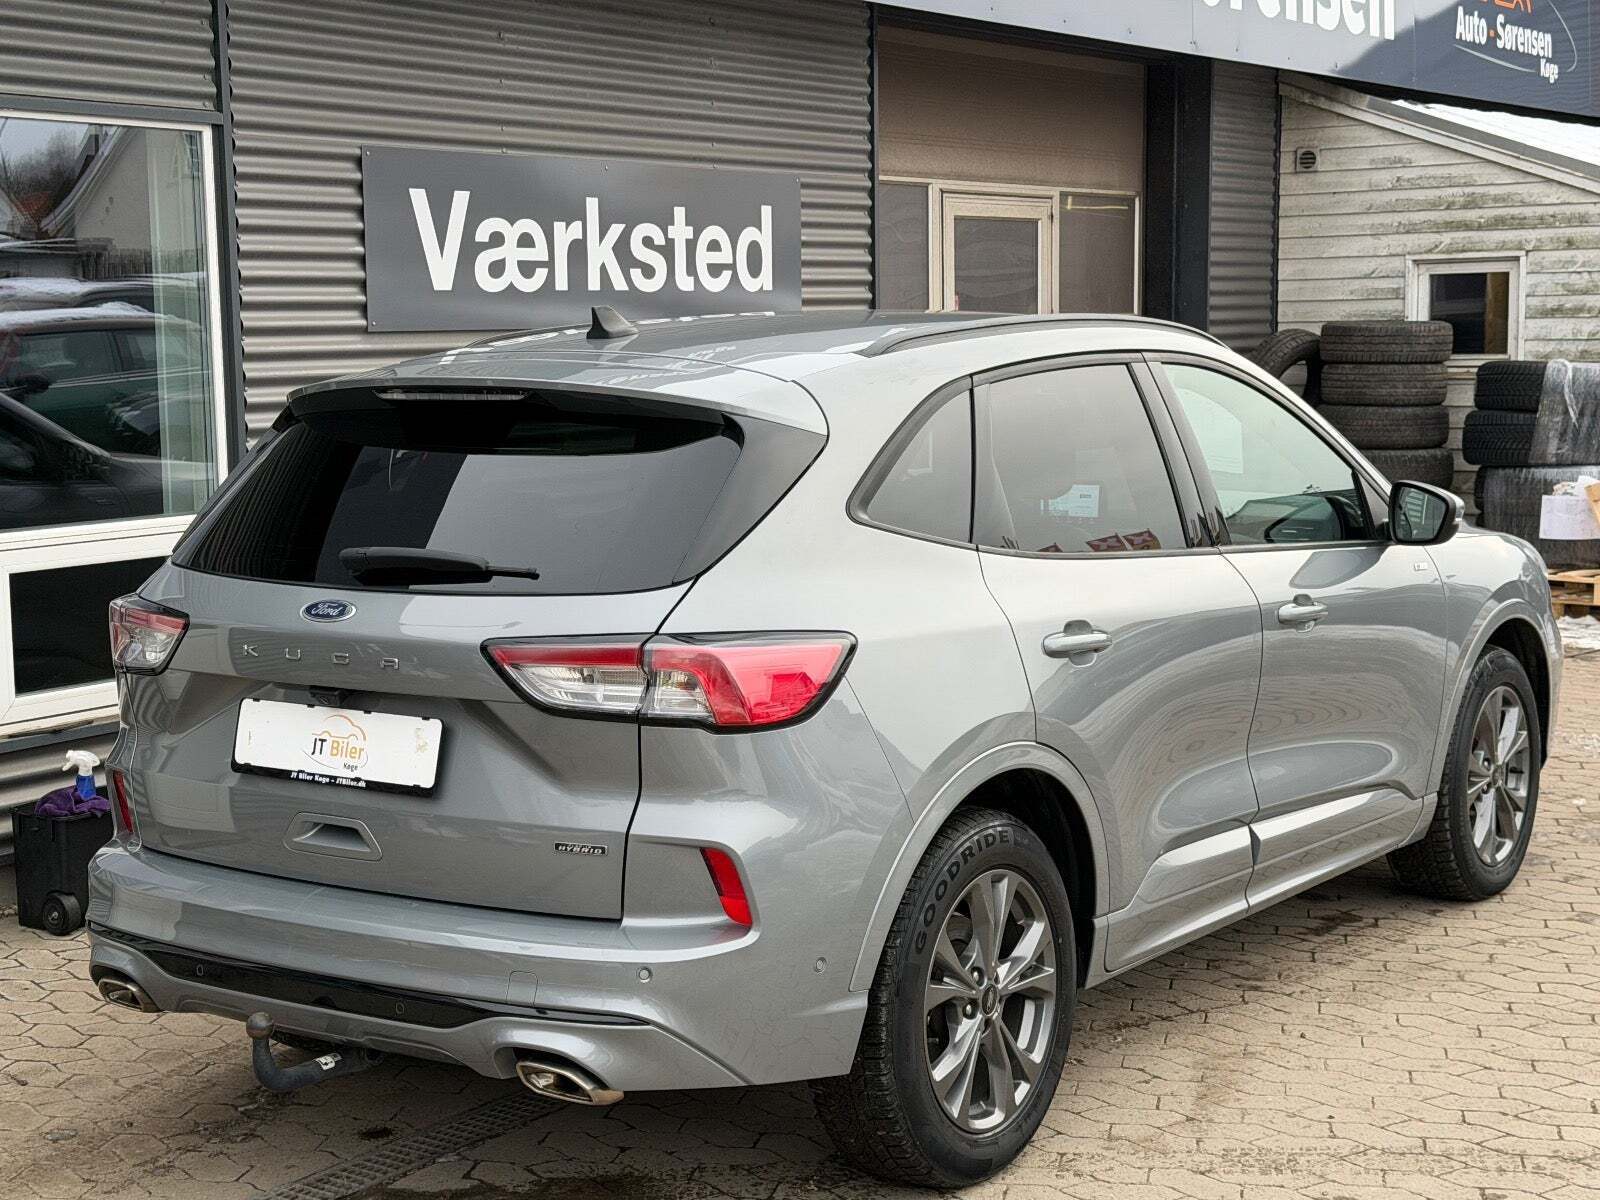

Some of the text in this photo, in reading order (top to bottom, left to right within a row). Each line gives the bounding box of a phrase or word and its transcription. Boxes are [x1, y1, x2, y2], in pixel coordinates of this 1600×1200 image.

[1456, 5, 1552, 58] Auto Sørensen
[408, 187, 773, 293] Værksted
[243, 644, 399, 670] KUGA
[311, 737, 364, 760] JT Biler
[298, 772, 314, 781] Biler
[915, 828, 1010, 955] GOODRIDE
